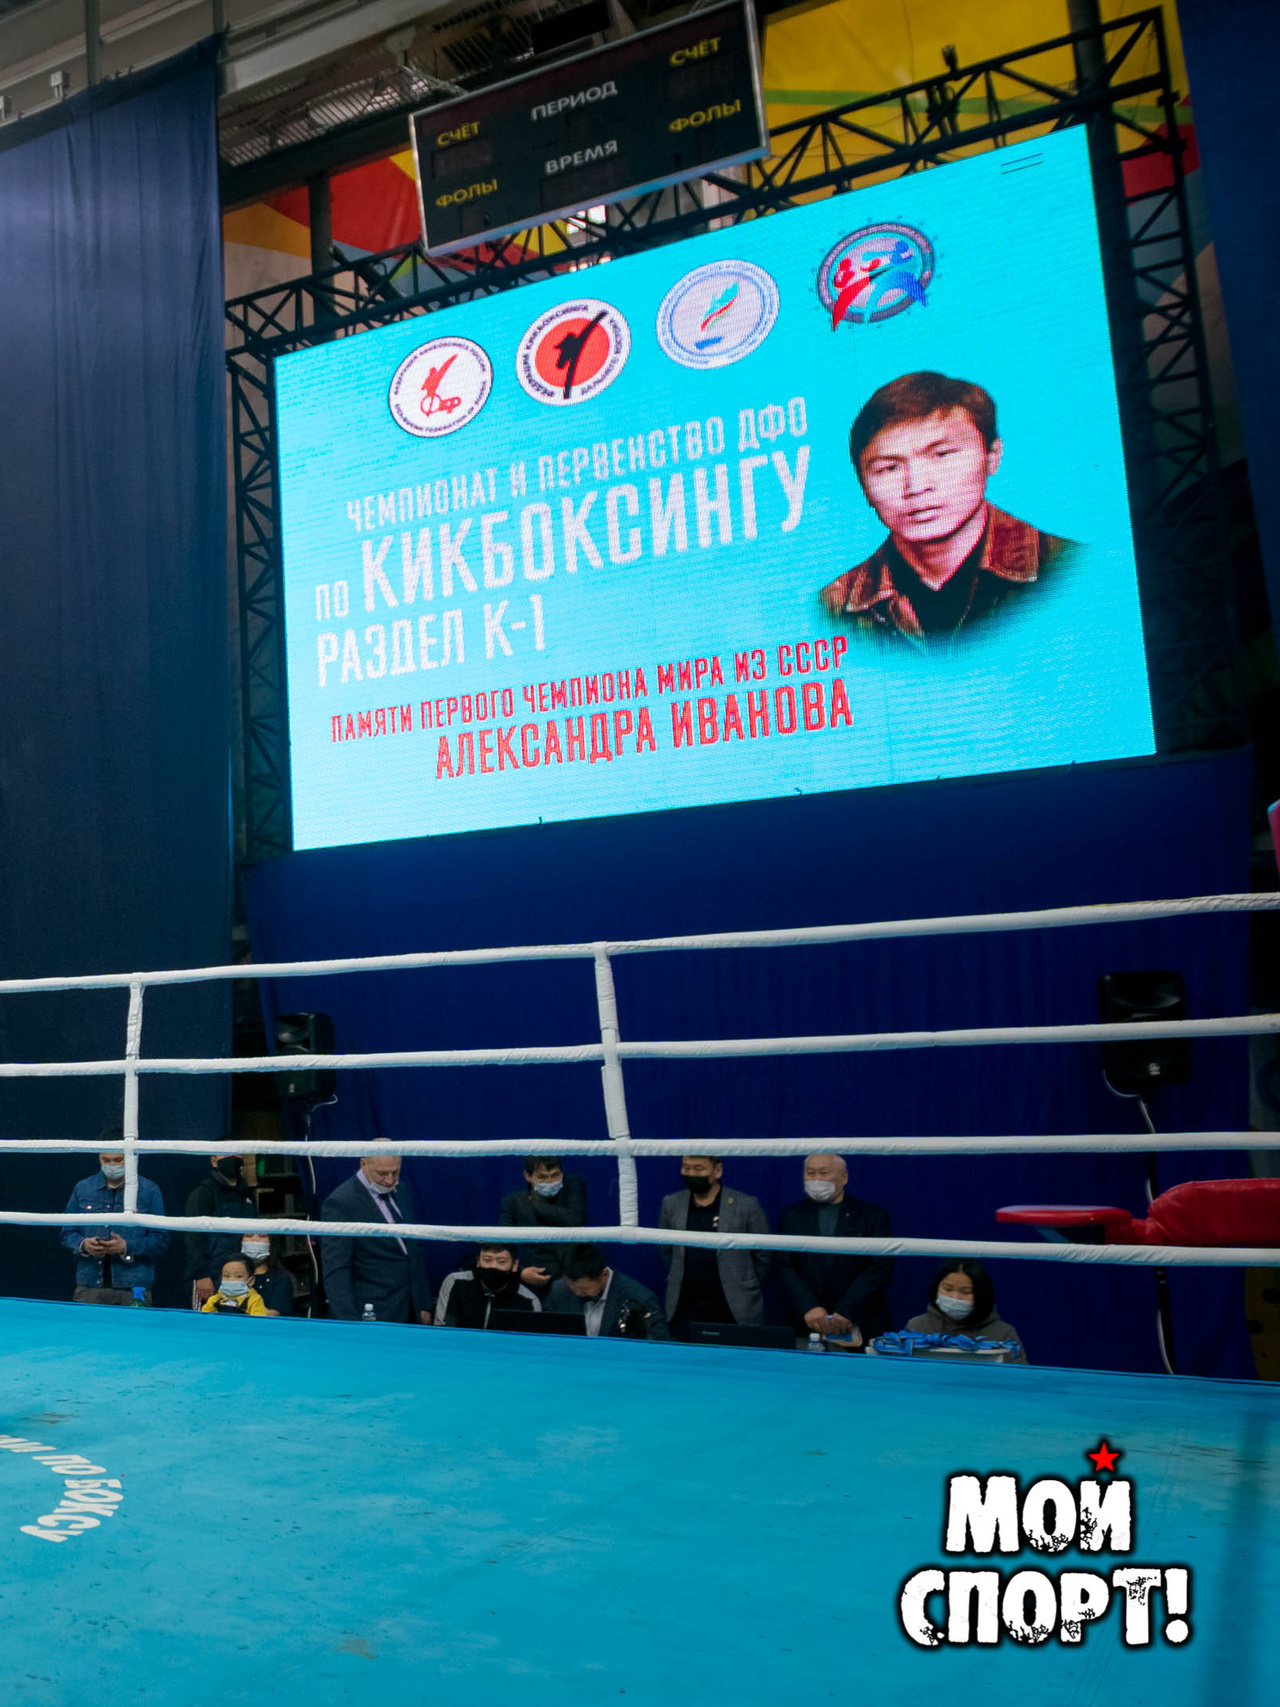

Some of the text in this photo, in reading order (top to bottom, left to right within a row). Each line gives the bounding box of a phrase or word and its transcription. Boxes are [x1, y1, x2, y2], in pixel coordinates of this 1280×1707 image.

[531, 80, 618, 121] ПЕРИОД
[669, 99, 741, 133] ФОЛЫ
[435, 179, 498, 207] ФОЛЫ
[545, 140, 618, 175] ВРЕМЯ
[347, 397, 808, 532] ЧЕМПИОНАТ И ПЕРВЕНСТВО ДФО
[315, 446, 810, 621] ПО КИКБОКСИНГУ
[317, 594, 546, 688] РАЗДЕЛ К-1
[331, 635, 848, 743] ПАМЯТИ ПЕРВОГО ЧЕМПИОНА МИРА ИЗ СССР
[435, 677, 854, 781] АЛЕКСАНДРА ИВАНОВА
[19, 1478, 125, 1544] БОКСУ
